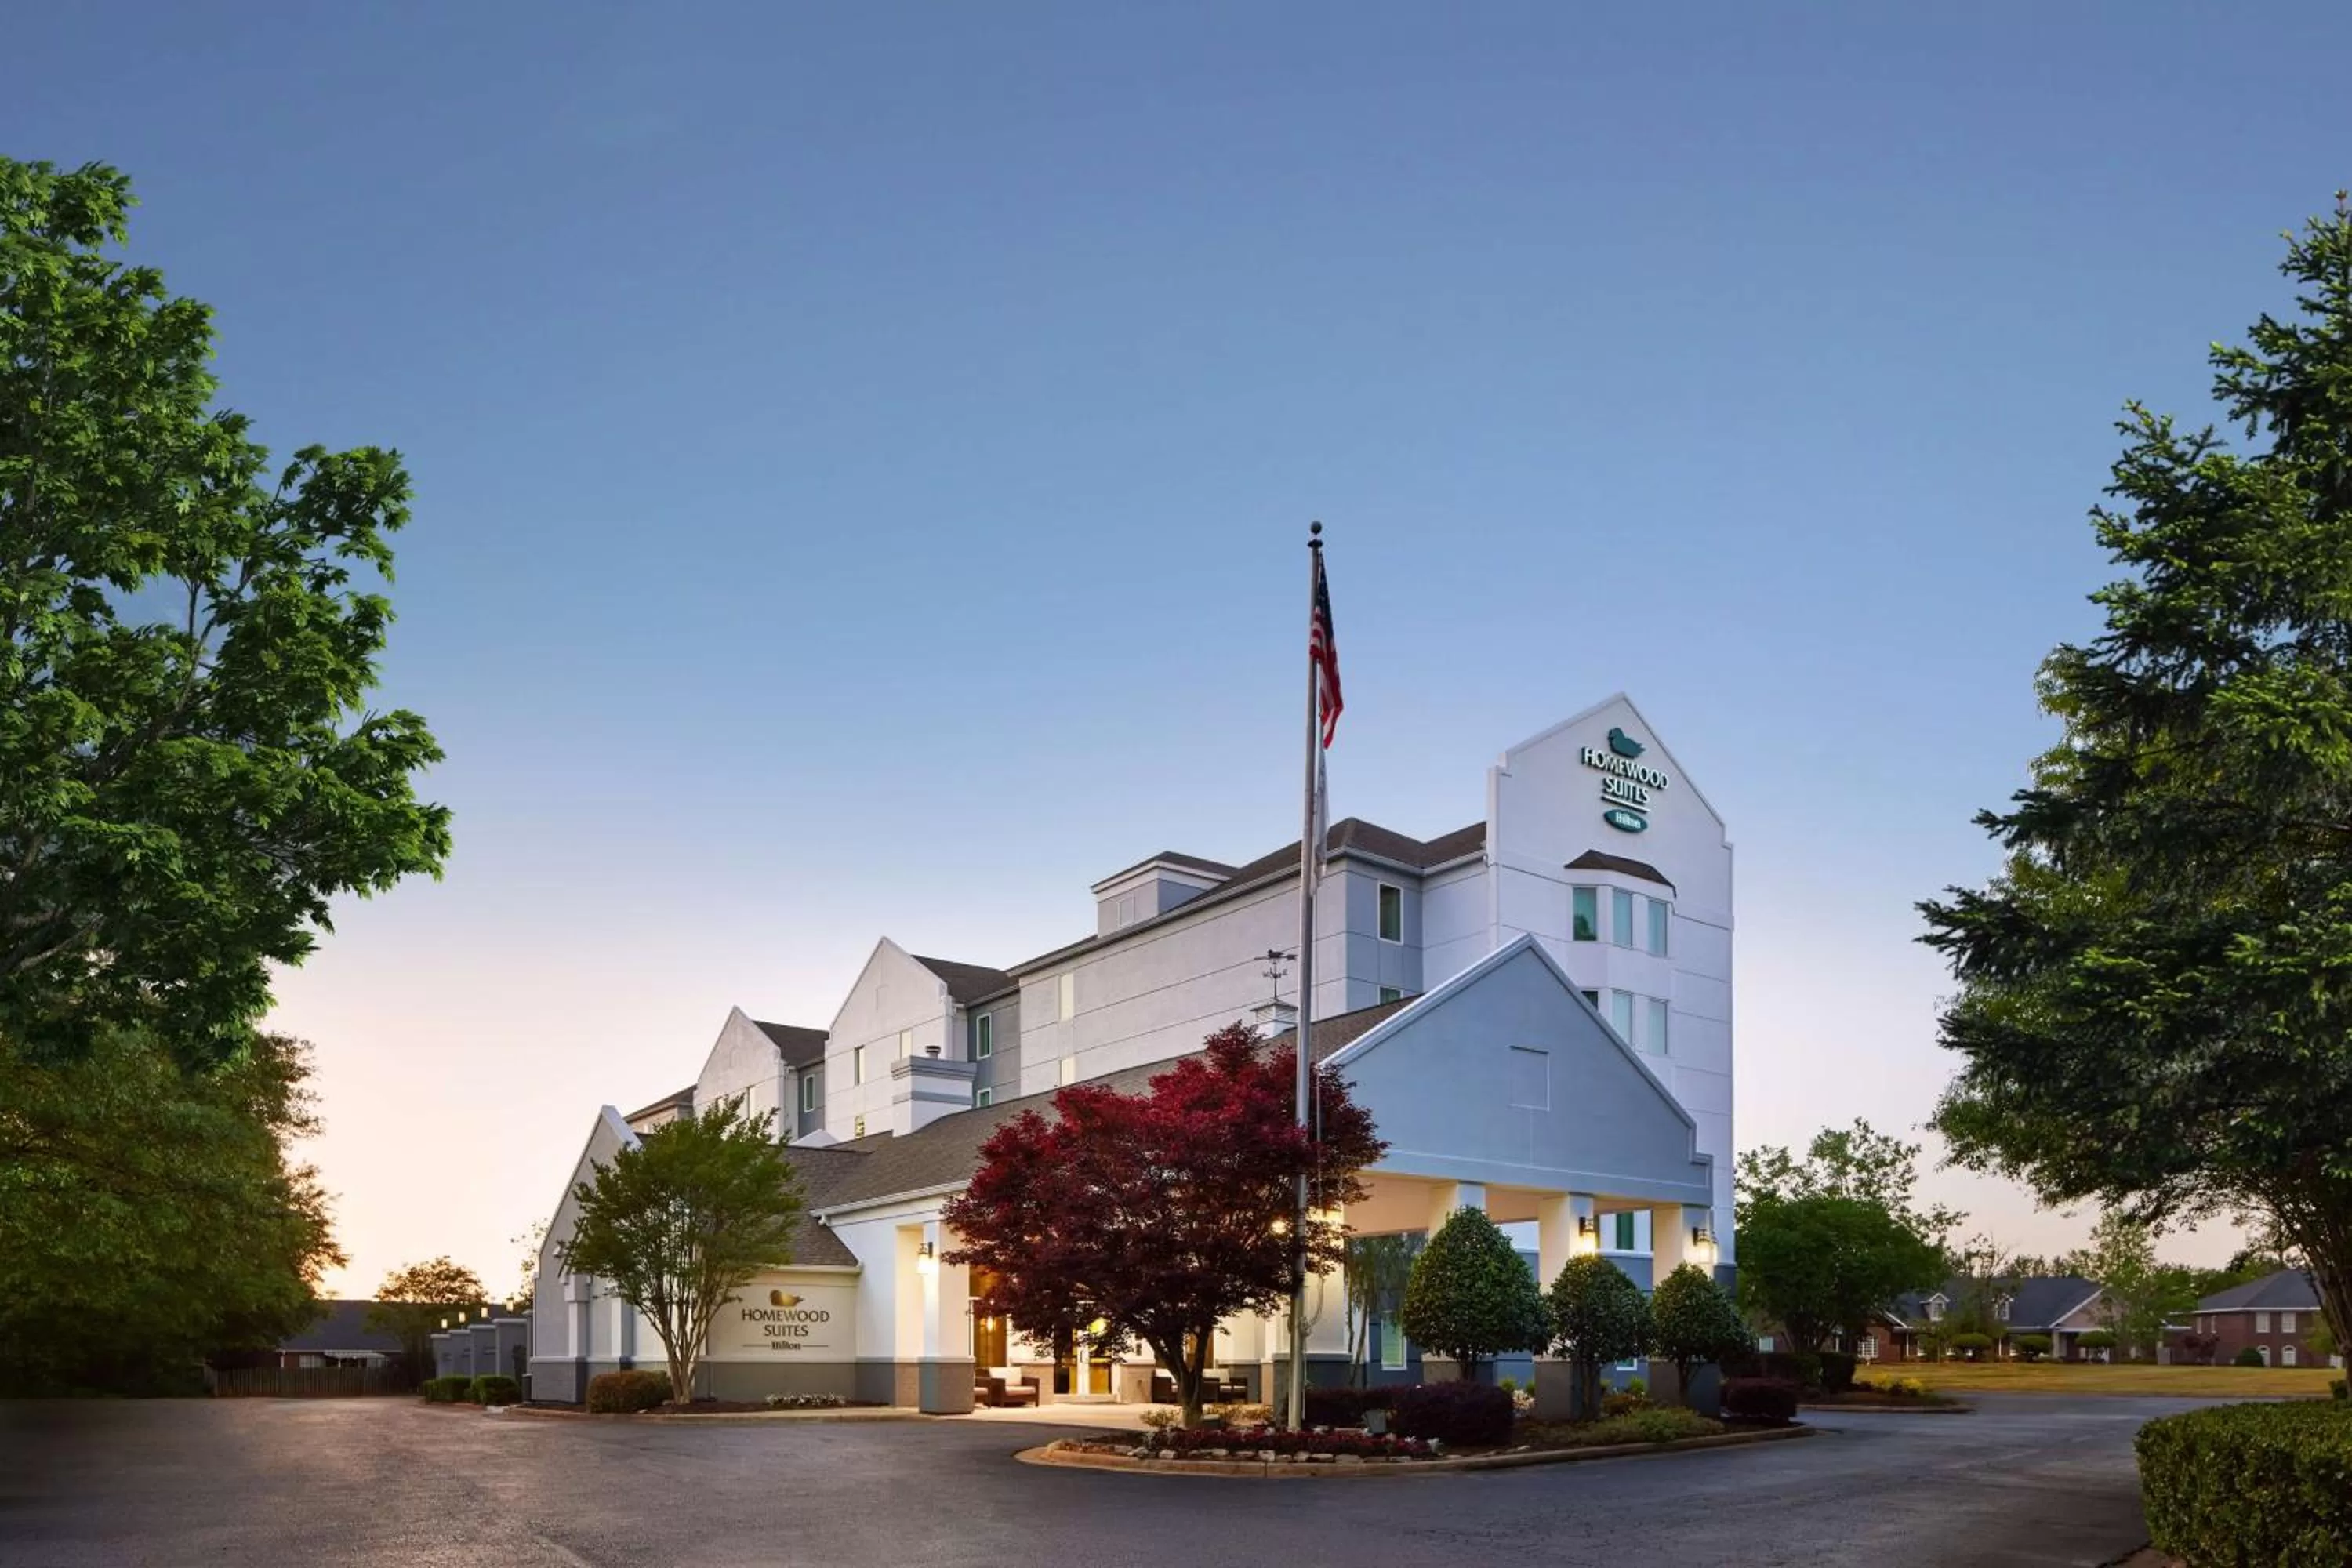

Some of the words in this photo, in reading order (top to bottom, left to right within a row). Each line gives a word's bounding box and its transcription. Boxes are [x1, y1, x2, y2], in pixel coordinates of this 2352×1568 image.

[1581, 746, 1669, 789] HOMEWOOD
[1605, 775, 1650, 804] SUITES
[1615, 811, 1641, 829] Hilton
[742, 1308, 830, 1323] HOMEWOOD
[764, 1324, 808, 1337] SUITES
[771, 1341, 801, 1350] Hilton
